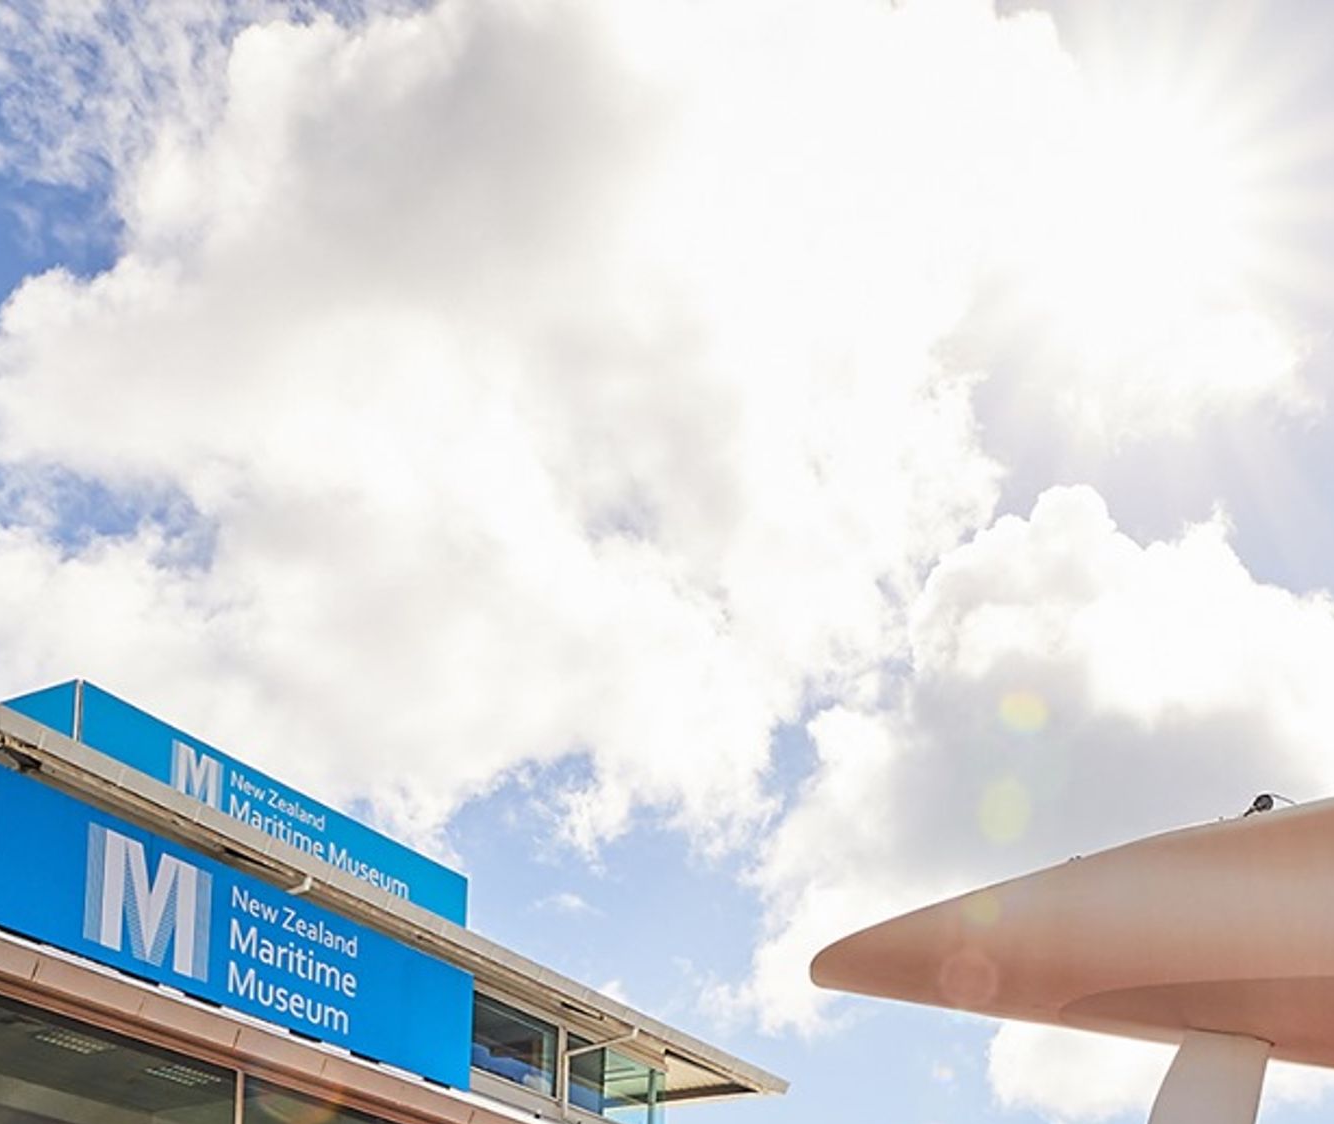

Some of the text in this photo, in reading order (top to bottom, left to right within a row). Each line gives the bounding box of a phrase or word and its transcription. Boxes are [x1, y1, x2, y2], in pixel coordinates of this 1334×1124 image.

[230, 770, 327, 831] New Zealand
[229, 794, 410, 900] Maritime Museum
[83, 822, 213, 983] M
[231, 885, 358, 960] New Zealand
[229, 918, 358, 998] Maritime
[227, 961, 350, 1035] Museum
